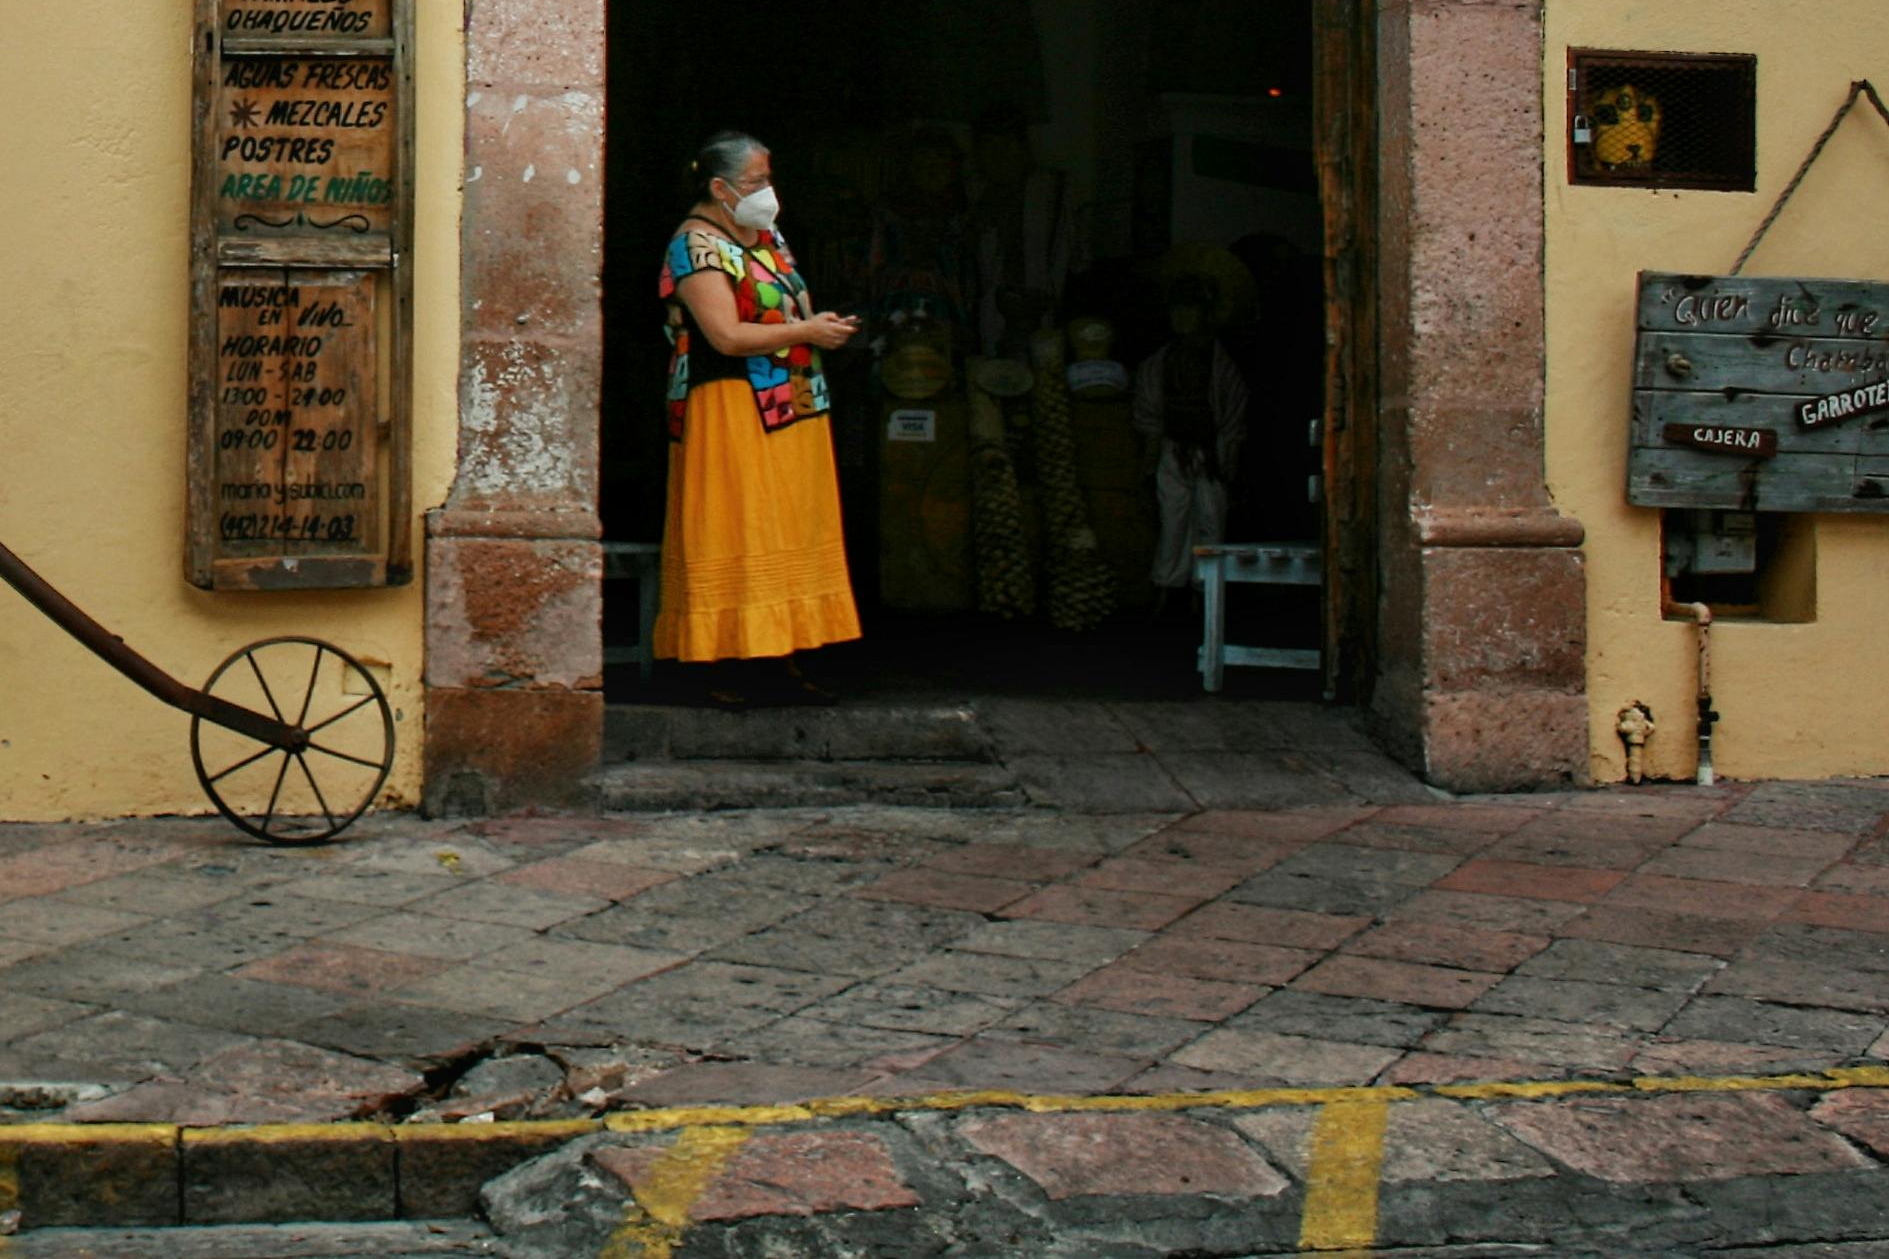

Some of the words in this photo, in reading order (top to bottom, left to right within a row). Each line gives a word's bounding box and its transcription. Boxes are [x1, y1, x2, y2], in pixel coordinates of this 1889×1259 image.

[227, 6, 373, 34] OHAQUEÑOS
[224, 61, 300, 90] AGUAS
[302, 62, 393, 91] FRESCAS
[264, 99, 389, 129] MEZCALES
[221, 135, 336, 166] POSTRES
[220, 172, 283, 200] AREA
[287, 174, 321, 204] DE
[324, 169, 395, 205] NIÑOS
[257, 309, 283, 326] EN
[1769, 292, 1820, 331] dice
[1835, 305, 1880, 337] que
[220, 335, 322, 358] HORARIO
[226, 359, 263, 383] LUN
[1801, 379, 1889, 425] GARROTE
[291, 427, 353, 452] 22:00
[1692, 427, 1762, 449] CAJERA
